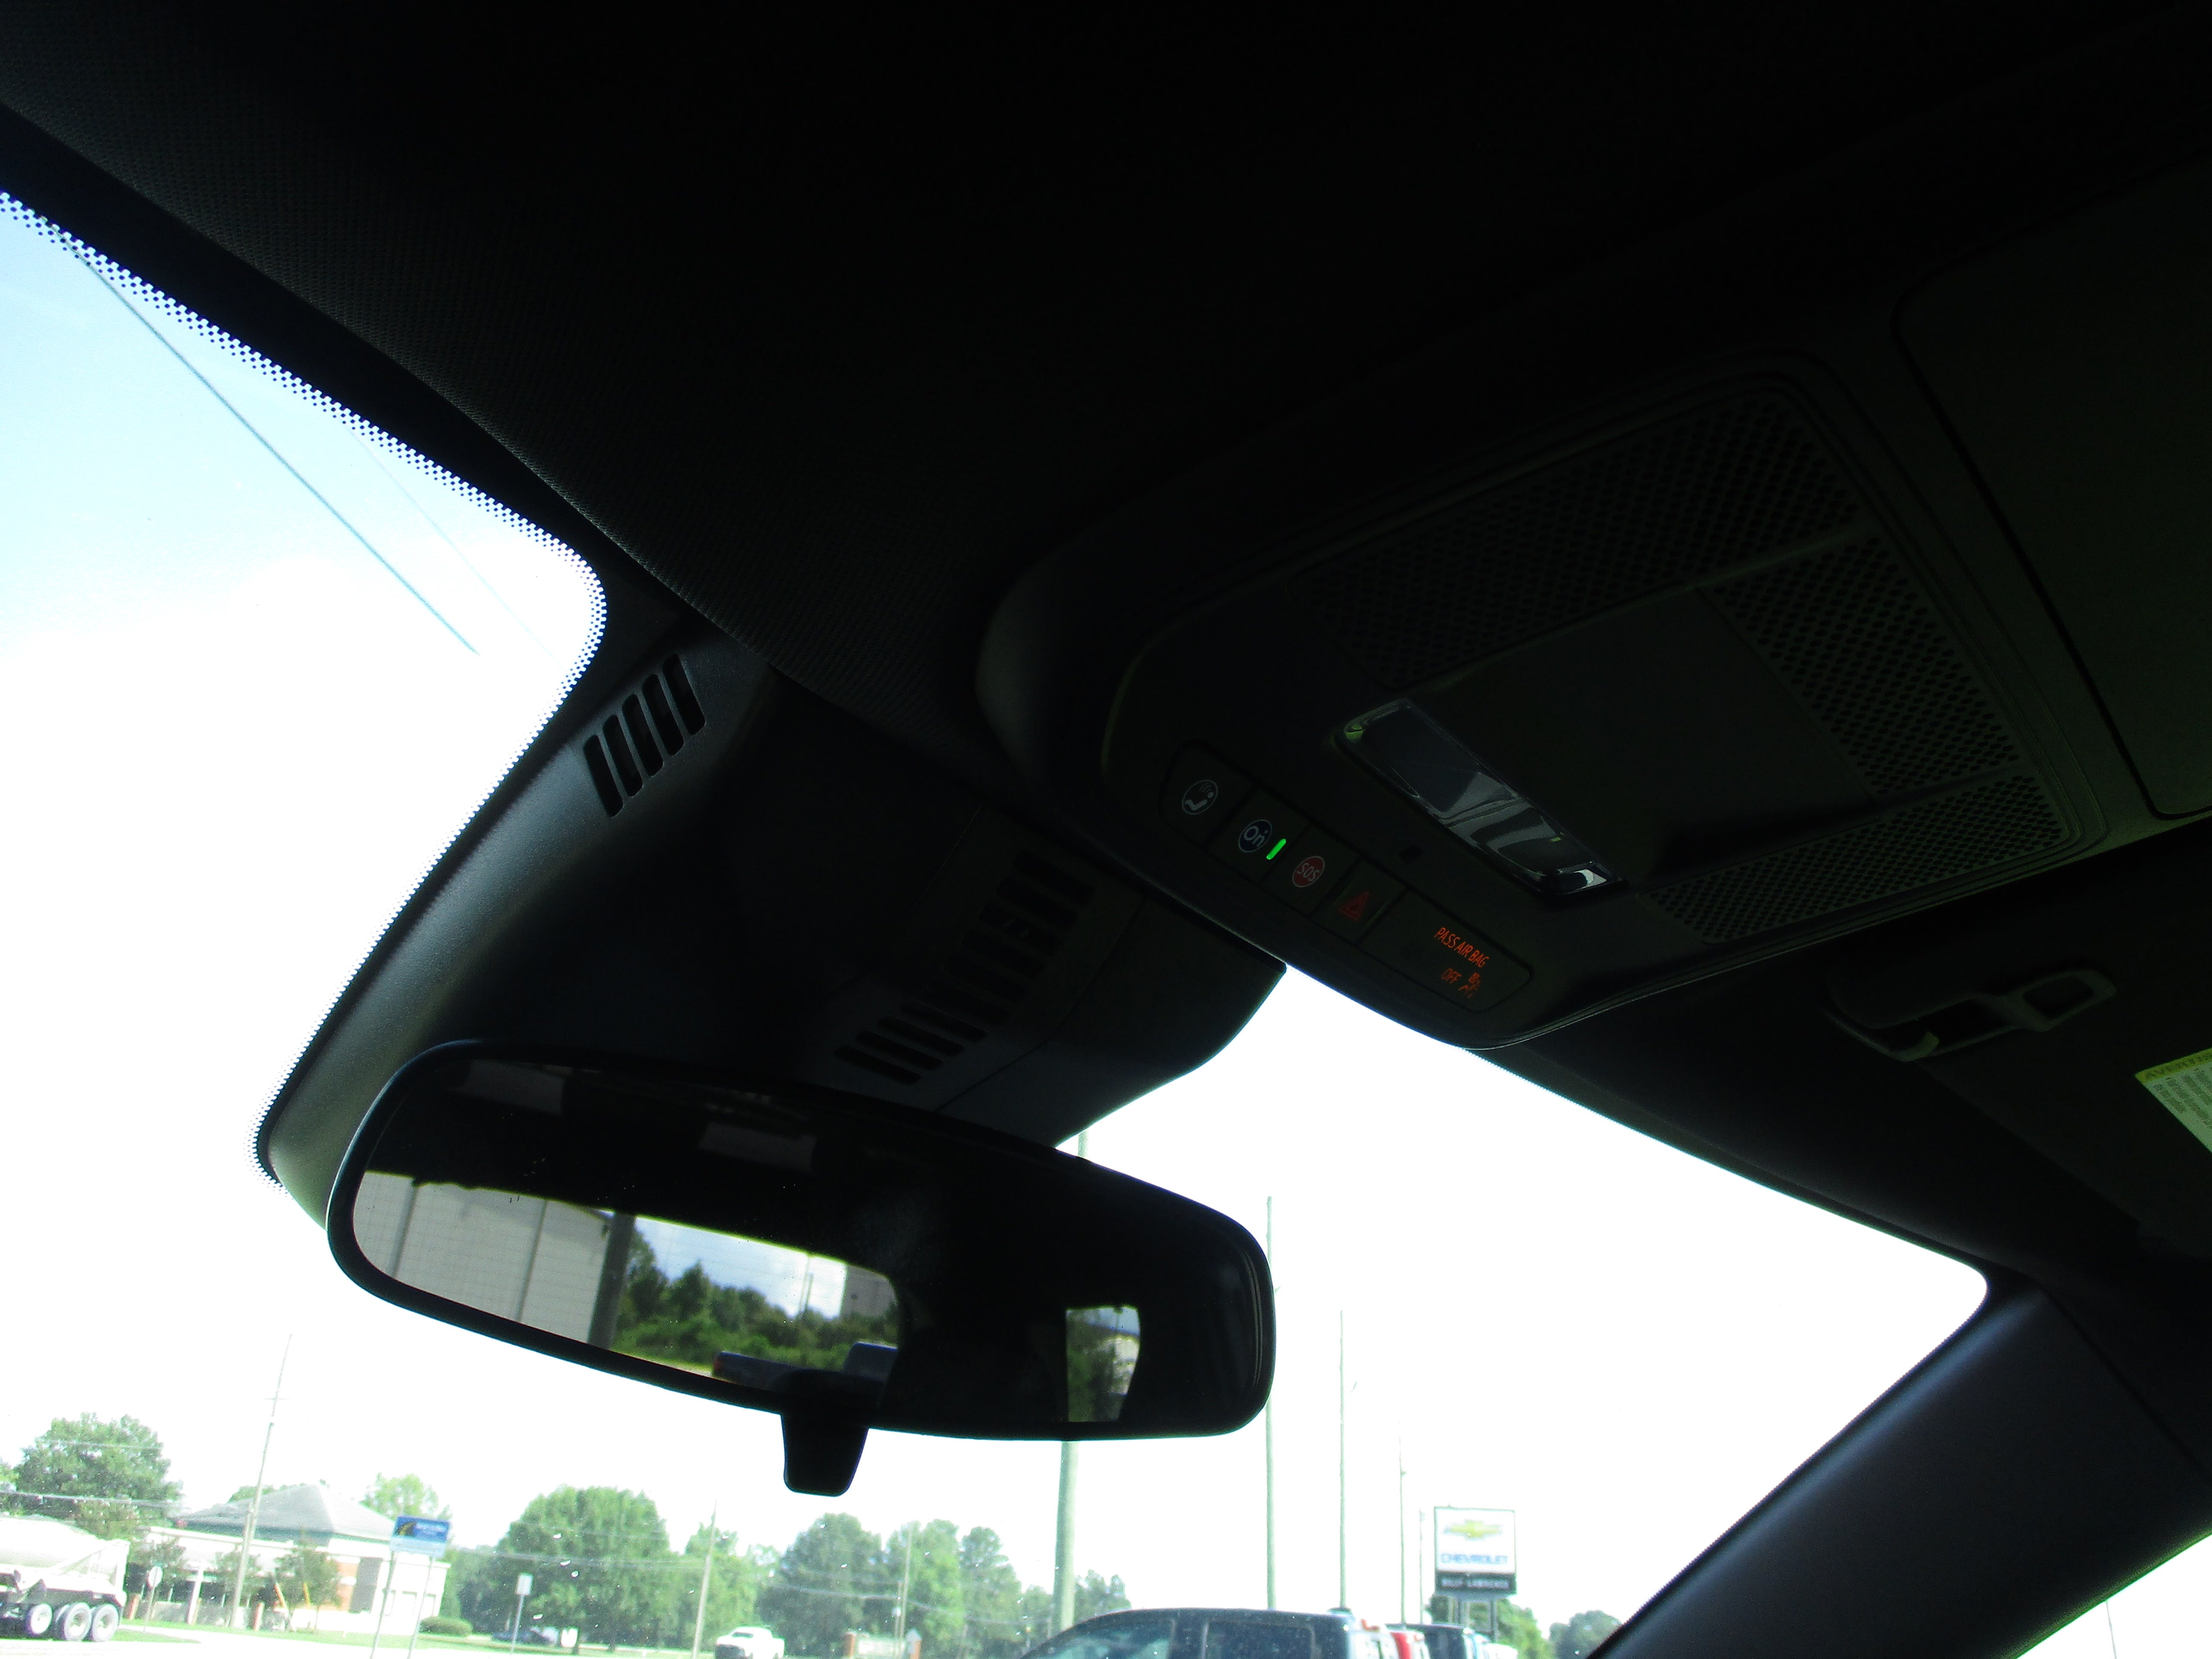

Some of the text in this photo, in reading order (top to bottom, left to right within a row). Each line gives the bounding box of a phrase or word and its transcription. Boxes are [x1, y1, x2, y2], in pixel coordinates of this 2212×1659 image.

[1296, 862, 1320, 881] SOS
[1434, 927, 1491, 968] PASS AIR BAG
[1441, 968, 1462, 984] OFF
